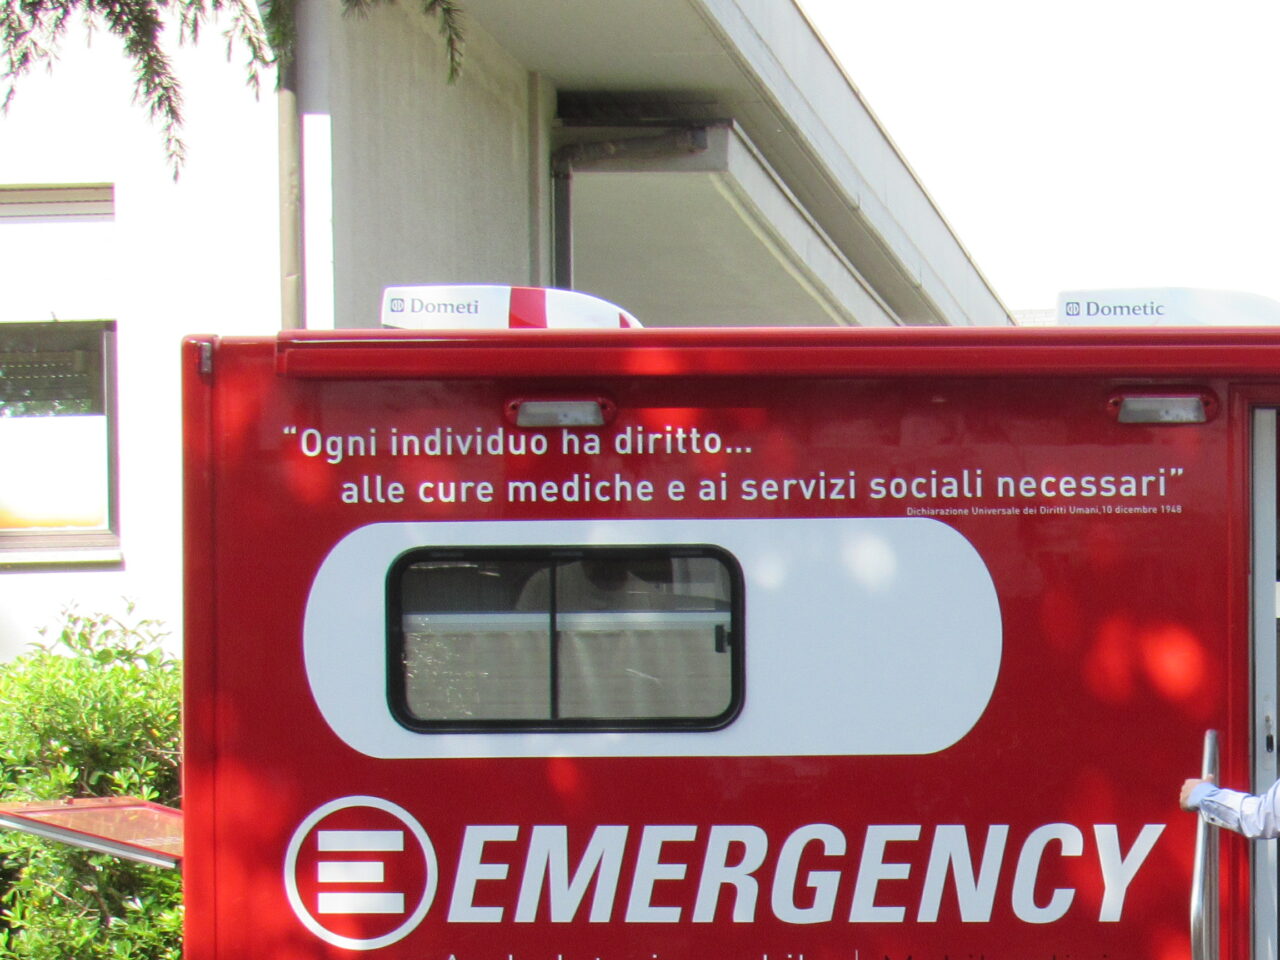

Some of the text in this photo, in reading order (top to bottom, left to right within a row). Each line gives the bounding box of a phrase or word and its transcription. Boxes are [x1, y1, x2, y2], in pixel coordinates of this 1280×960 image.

[411, 298, 479, 315] Dometi
[1086, 301, 1165, 317] Dometic
[391, 427, 548, 456] individuo
[561, 428, 600, 455] ha
[341, 475, 405, 503] alle
[418, 482, 494, 503] cure
[508, 474, 654, 503] mediche
[668, 481, 686, 502] e
[699, 473, 727, 502] ai
[741, 471, 856, 501] servizi
[869, 470, 982, 500] sociali
[906, 506, 969, 516] Dichiarazione
[971, 506, 1021, 515] Universale
[1023, 505, 1037, 515] dei
[1039, 505, 1067, 515] Diritti
[1115, 505, 1158, 514] dicembre
[1160, 504, 1182, 514] 1948
[446, 823, 1167, 925] EMERGENCY
